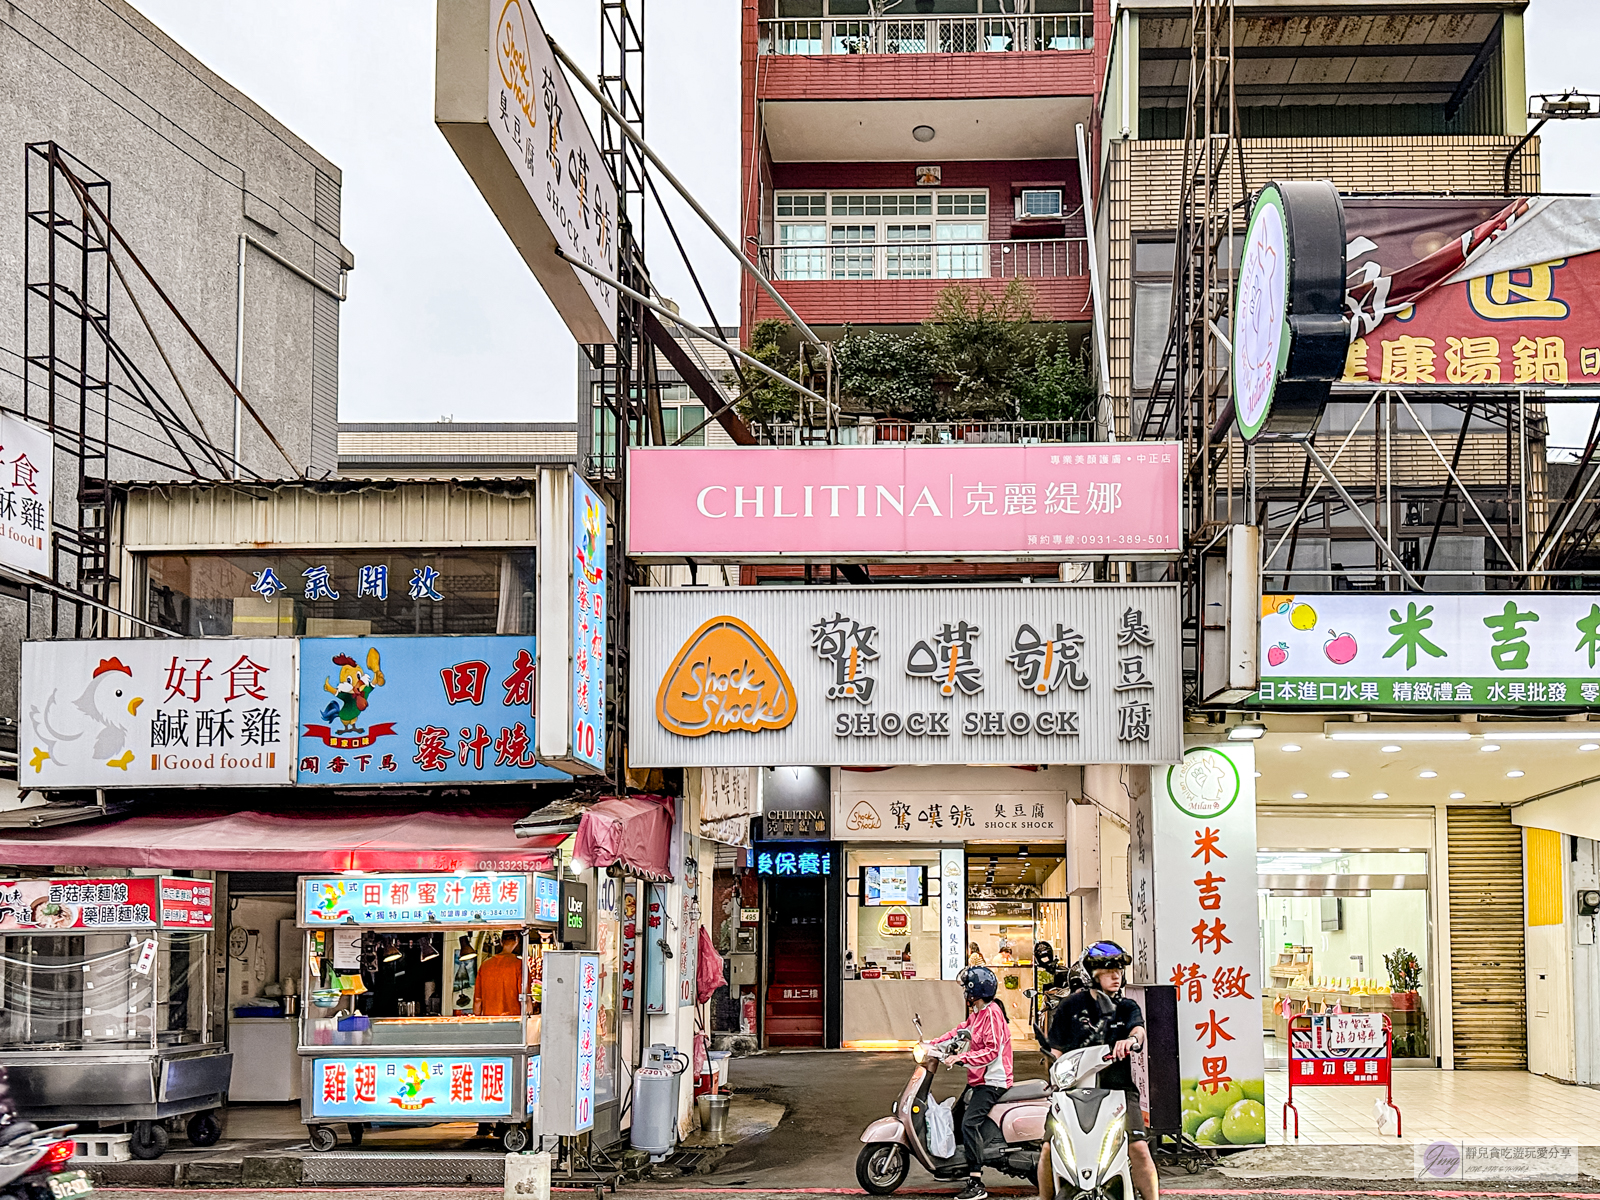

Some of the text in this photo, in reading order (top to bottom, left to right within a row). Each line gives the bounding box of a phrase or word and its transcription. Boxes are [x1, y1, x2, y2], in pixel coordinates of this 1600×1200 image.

[499, 90, 534, 177] 臭豆腐
[546, 181, 579, 252] SHOCK
[0, 445, 39, 495] 食
[696, 484, 943, 519] CHLITINA
[962, 482, 1122, 516] 克麗緹娜
[8, 526, 35, 548] food
[251, 565, 445, 602] 冷氣開放
[163, 655, 270, 703] 好食
[682, 659, 765, 702] Shock
[1116, 605, 1156, 742] 臭豆腐
[1258, 682, 1380, 702] 日本進口水果
[1392, 682, 1474, 702] 精緻禮盒
[1486, 682, 1568, 702] 水果批發
[150, 708, 281, 748] 鹹酥雞
[835, 710, 1080, 737] SHOCK SHOCK
[576, 720, 595, 758] 10
[164, 753, 262, 770] Good food
[299, 754, 398, 775] 聞香下馬
[767, 810, 825, 820] CHLITINA
[994, 803, 1045, 819] 臭豆腐
[984, 821, 1055, 829] SHOCK SHOCK
[49, 883, 129, 903] 香菇素麵線
[312, 883, 358, 892] 日 式
[363, 880, 520, 906] 田都蜜汁燒烤
[1191, 826, 1234, 955] 米吉林
[82, 905, 151, 924] 藥膳麵線
[568, 896, 583, 913] Uber
[567, 912, 583, 929] Eats
[681, 980, 690, 1000] 10
[1169, 963, 1254, 1004] 精緻
[1194, 1008, 1237, 1096] 水果
[1300, 1061, 1378, 1075] 請勿停車
[322, 1064, 378, 1104] 雞翅
[386, 1063, 396, 1076] 日
[432, 1063, 444, 1076] 式
[450, 1064, 505, 1103] 雞腿
[578, 1097, 589, 1124] 10
